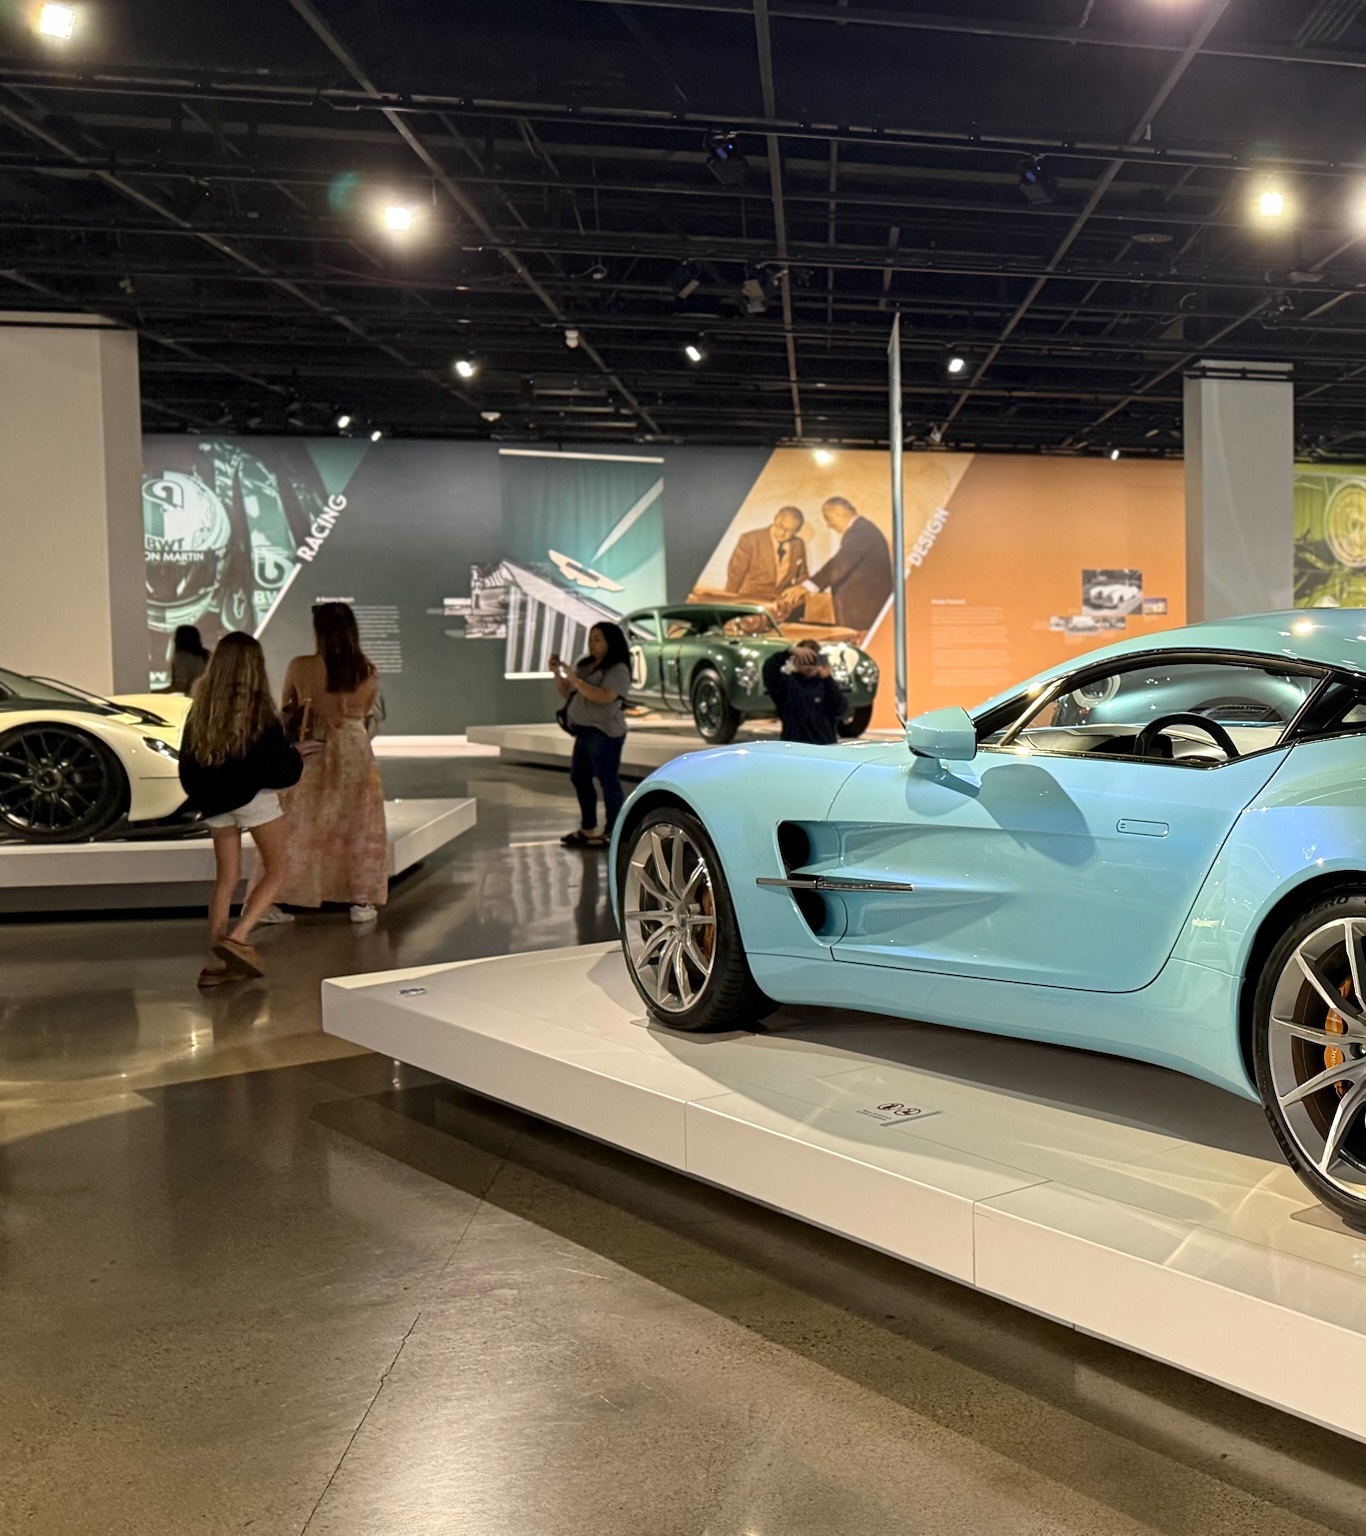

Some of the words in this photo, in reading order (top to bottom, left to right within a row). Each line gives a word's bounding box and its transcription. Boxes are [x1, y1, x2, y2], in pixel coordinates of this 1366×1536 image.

[146, 537, 184, 549] BWT
[296, 494, 348, 563] RACING
[907, 506, 950, 568] DESIGN
[162, 552, 204, 562] MARTIN
